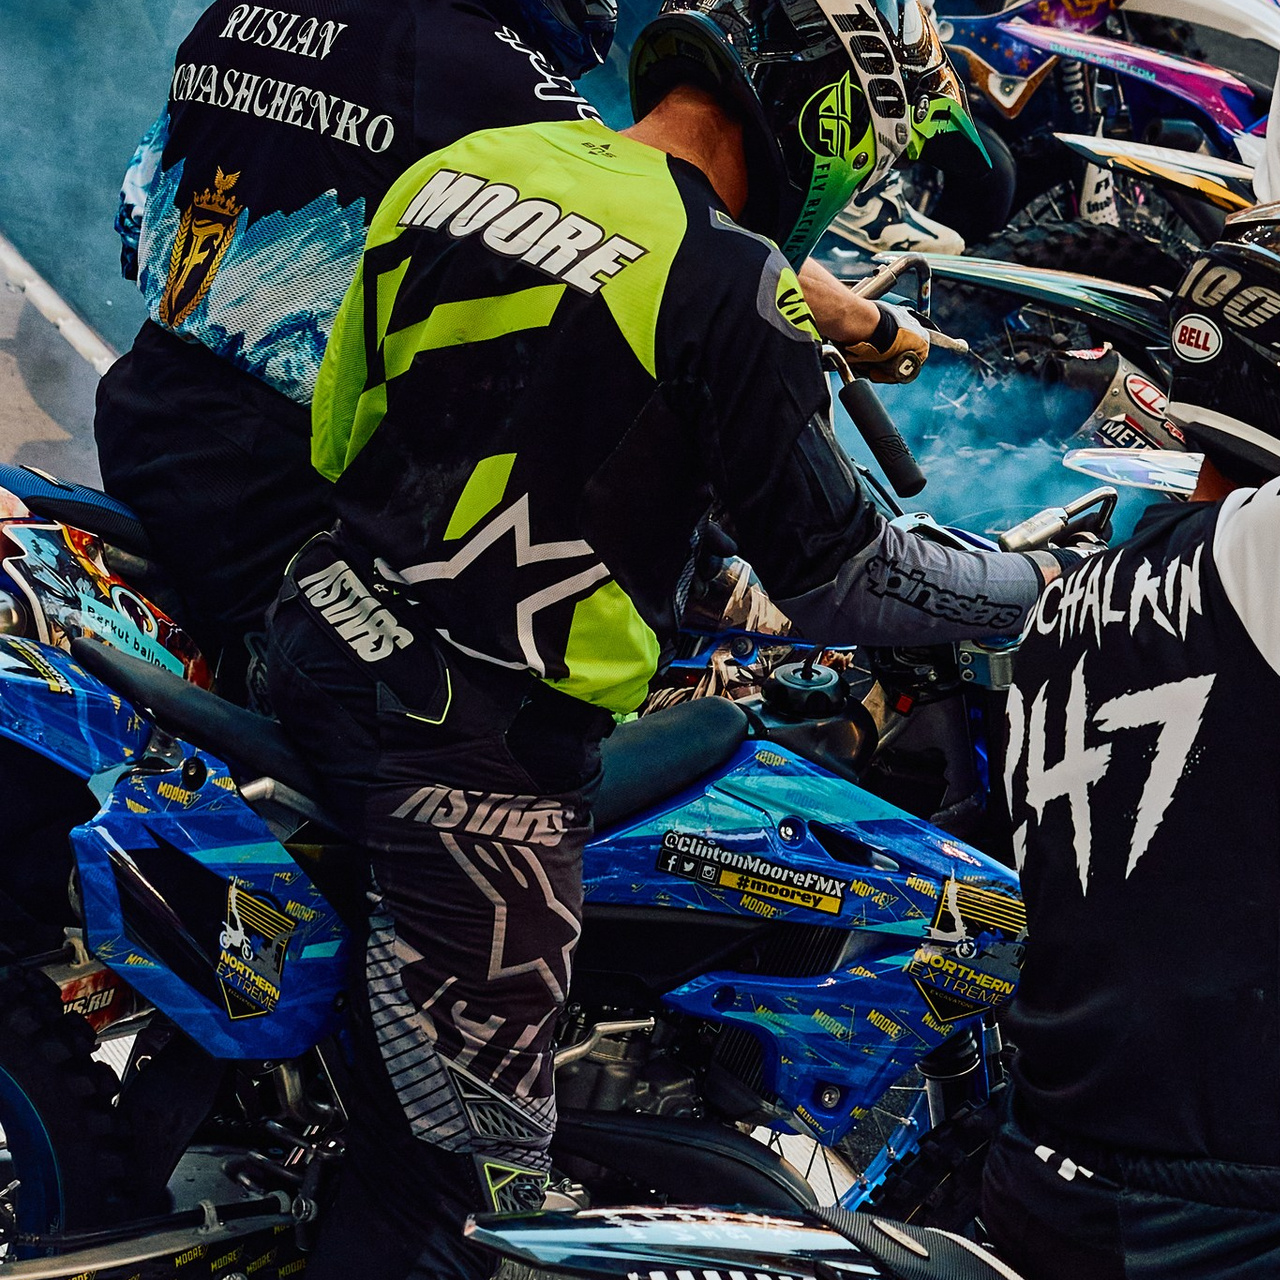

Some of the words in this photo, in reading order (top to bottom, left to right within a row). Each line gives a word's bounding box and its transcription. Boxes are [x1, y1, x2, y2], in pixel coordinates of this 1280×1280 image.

[219, 3, 348, 60] RUSLAN
[397, 168, 651, 298] MOORE
[1177, 324, 1211, 353] BELL
[86, 604, 131, 644] Berkut
[1002, 648, 1219, 898] 47
[664, 831, 847, 898] @ClintonMooreFMX
[736, 874, 824, 909] #moorey
[215, 964, 277, 1013] EXTREME
[218, 948, 281, 1001] NORTHERN
[907, 960, 1007, 1006] EXTREME
[913, 947, 1016, 995] NORTHERN
